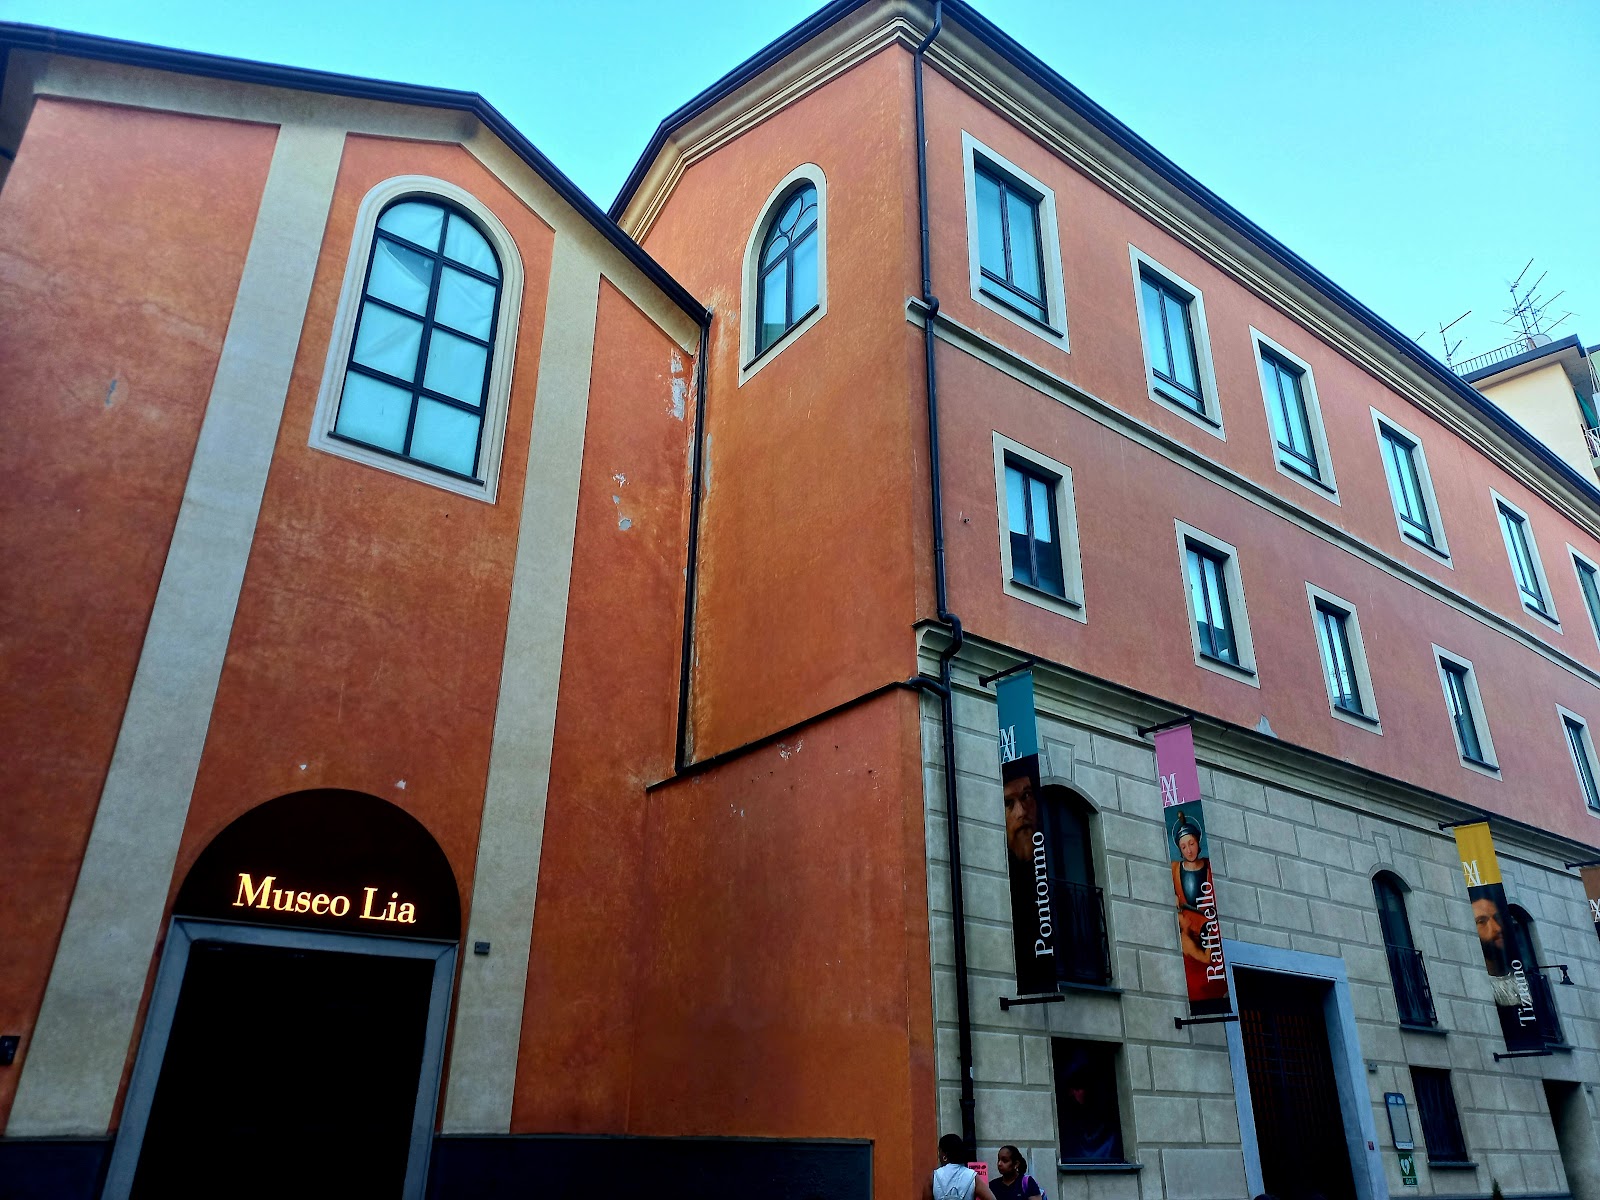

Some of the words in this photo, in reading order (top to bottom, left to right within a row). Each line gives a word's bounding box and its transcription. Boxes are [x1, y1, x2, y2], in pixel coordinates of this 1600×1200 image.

[233, 873, 351, 917] Museo
[359, 887, 416, 924] Lia
[1032, 832, 1054, 957] Pontormo
[1196, 881, 1226, 983] Raffaello
[1511, 960, 1536, 1026] Tiziano
